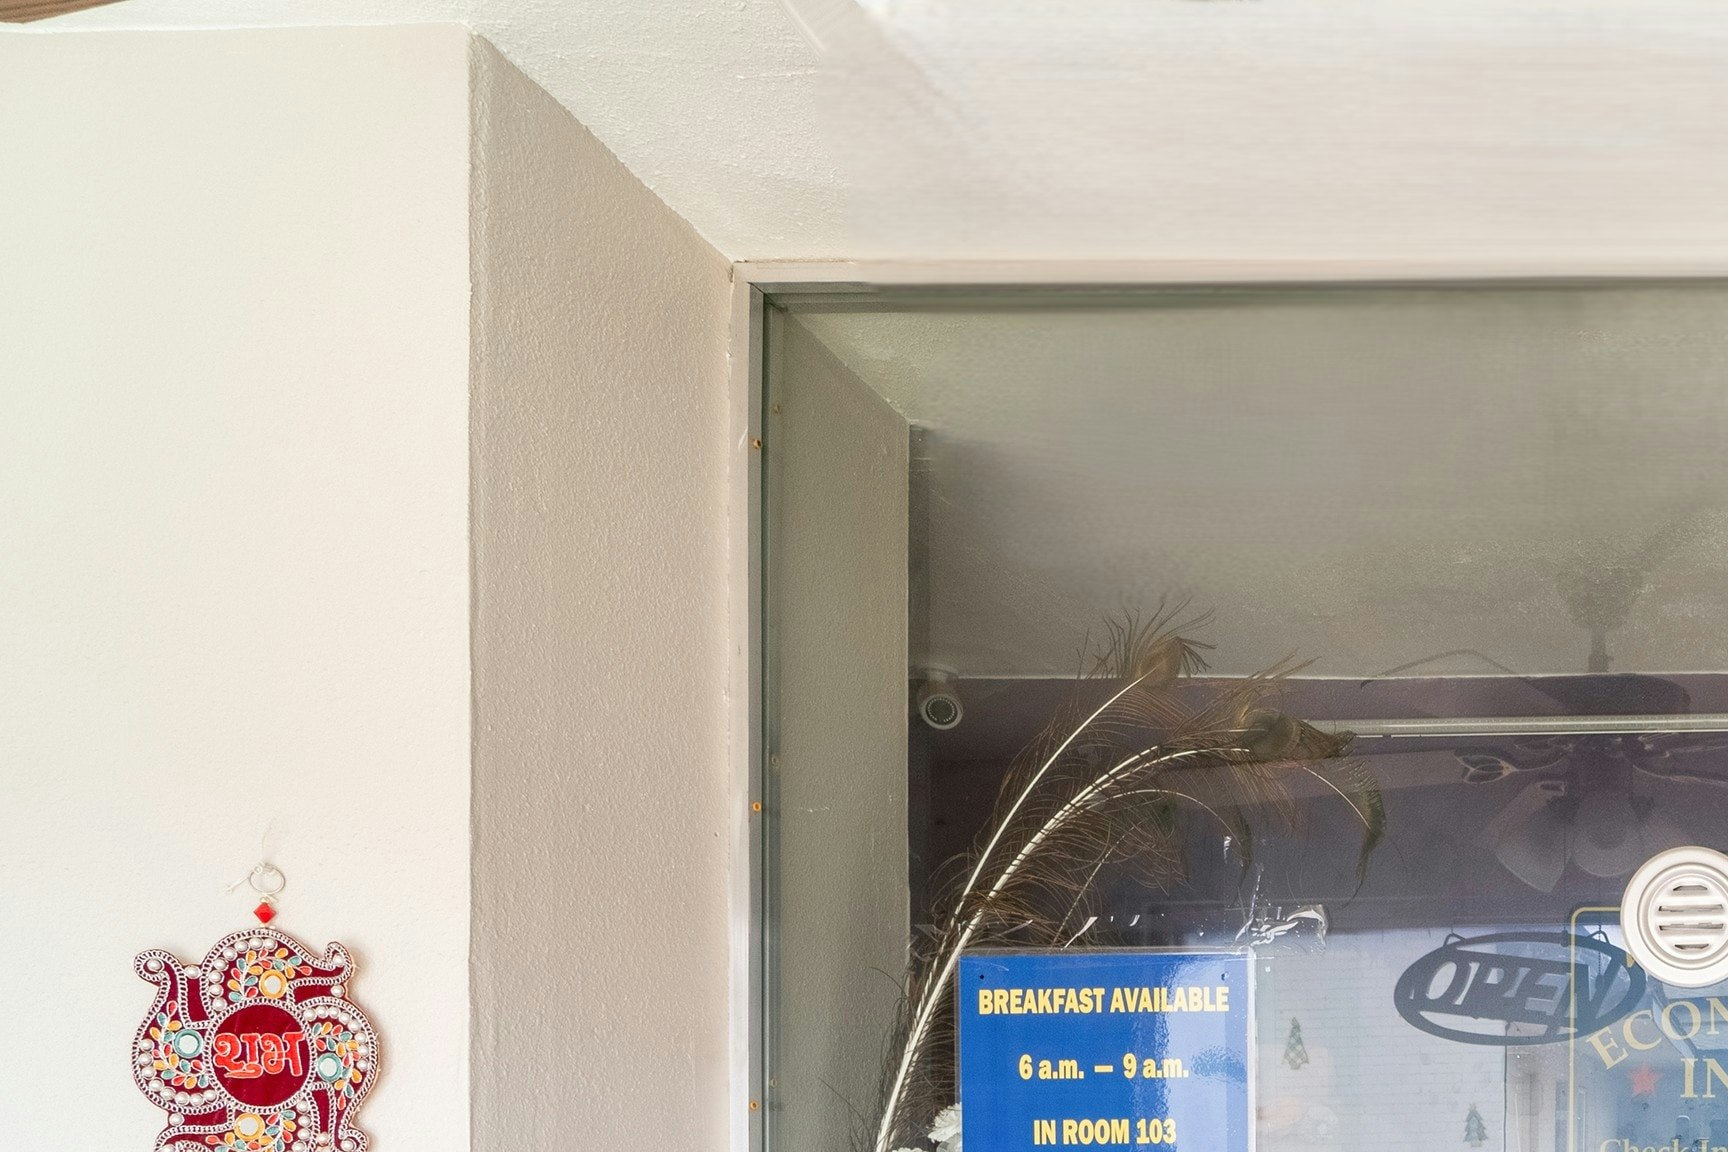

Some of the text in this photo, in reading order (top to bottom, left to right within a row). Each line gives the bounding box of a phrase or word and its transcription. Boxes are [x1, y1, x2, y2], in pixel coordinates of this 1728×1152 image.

[979, 987, 1229, 1014] BREAKFAST AVAILABLE
[1410, 957, 1613, 1022] OPEN
[213, 1030, 306, 1078] शुभ
[1019, 1054, 1032, 1079] 6
[1039, 1059, 1084, 1079] a.m.
[1123, 1054, 1137, 1078] 9
[1143, 1057, 1188, 1078] a.m.
[1034, 1119, 1176, 1145] IN ROOM 103
